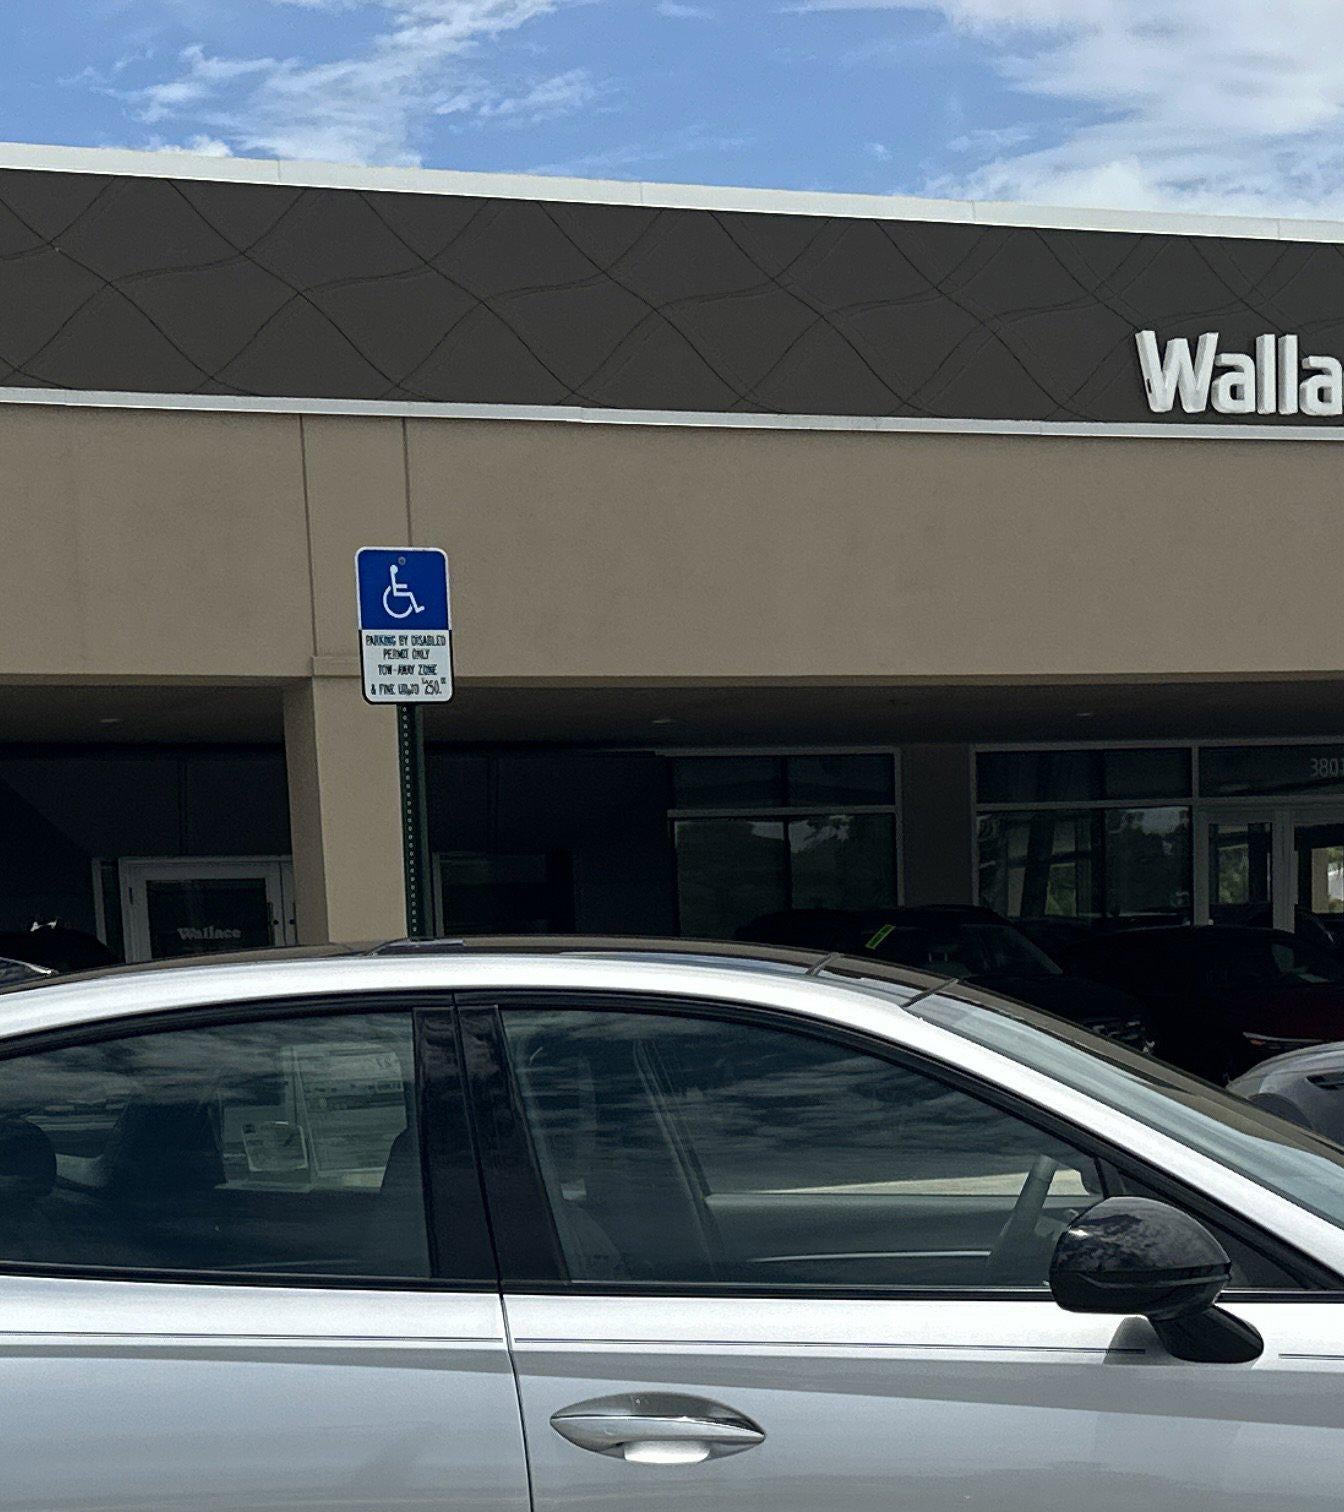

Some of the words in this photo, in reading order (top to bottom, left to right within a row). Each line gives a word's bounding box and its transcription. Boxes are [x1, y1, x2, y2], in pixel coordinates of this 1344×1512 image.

[365, 635, 396, 646] PARKING
[399, 635, 408, 646] BY
[411, 635, 446, 646] DISABLED
[383, 648, 409, 660] PERMIT
[412, 648, 430, 660] ONLY
[418, 664, 437, 675] ZONE
[379, 684, 395, 695] FINE
[177, 925, 242, 940] Wallace
